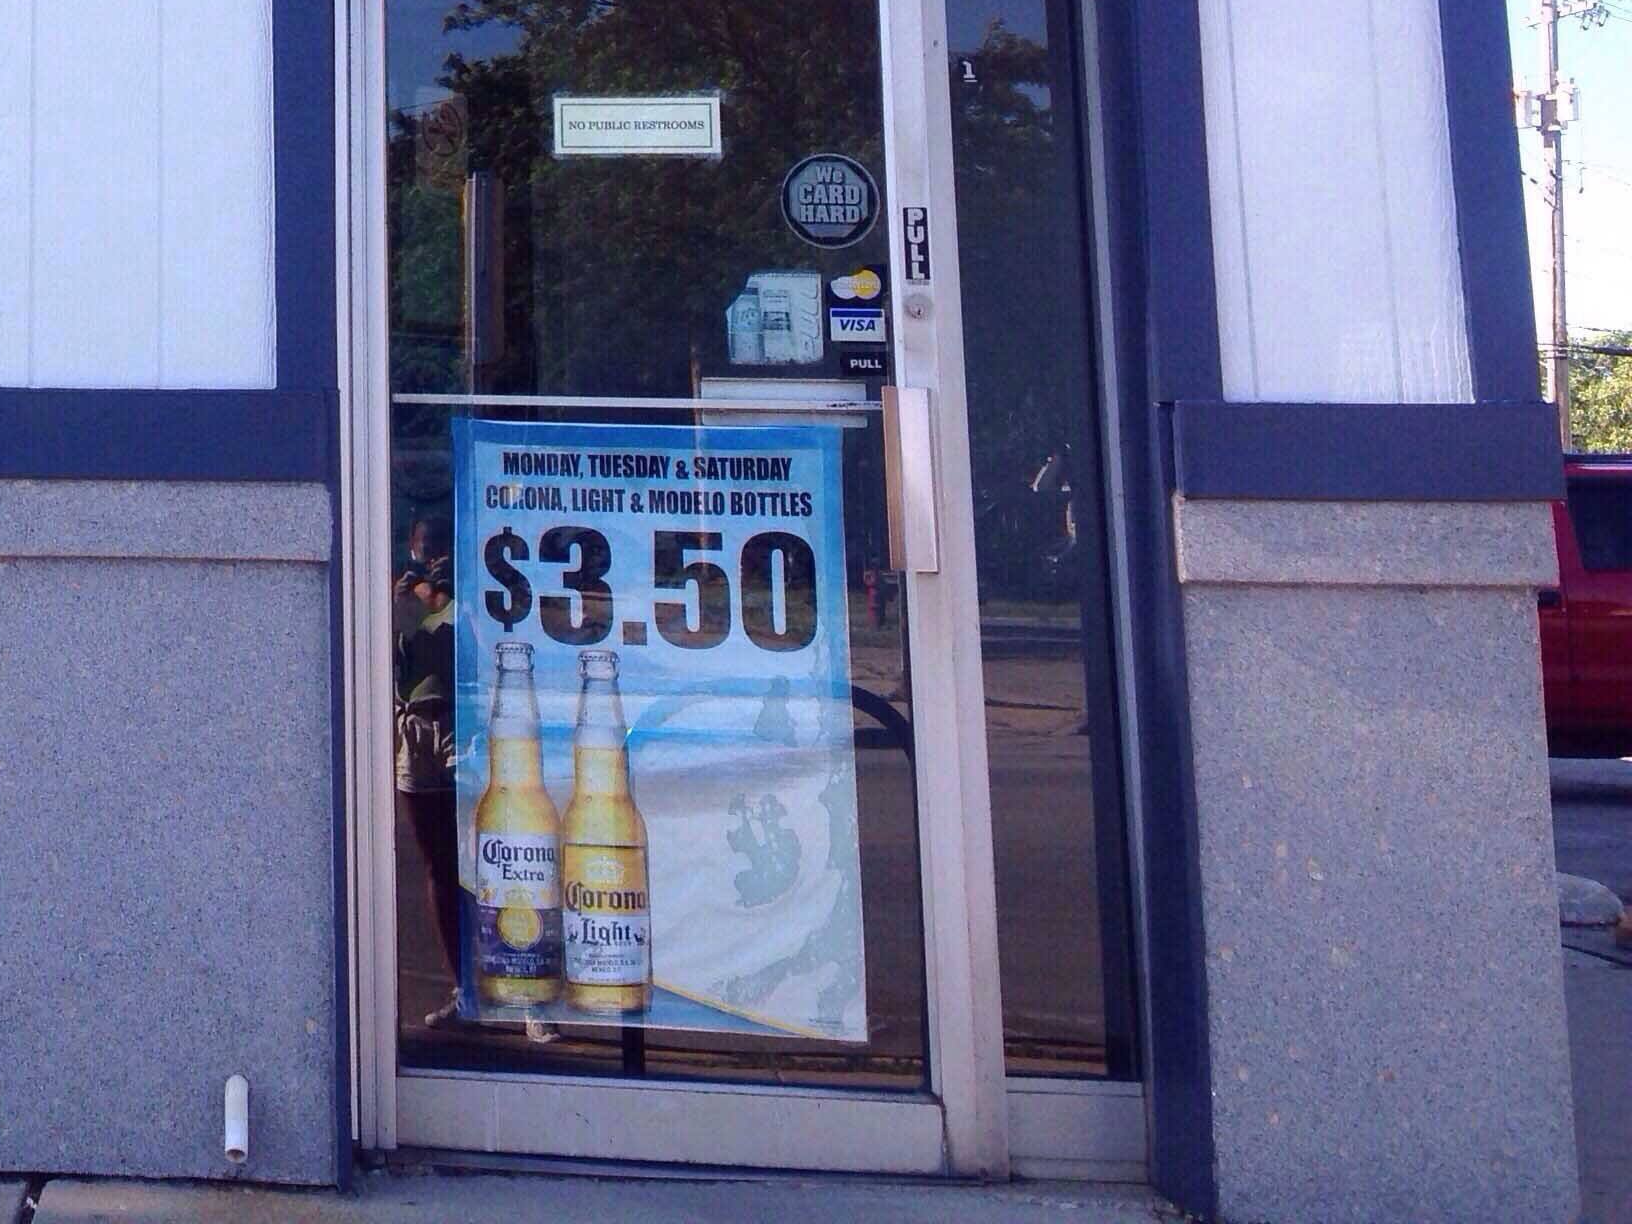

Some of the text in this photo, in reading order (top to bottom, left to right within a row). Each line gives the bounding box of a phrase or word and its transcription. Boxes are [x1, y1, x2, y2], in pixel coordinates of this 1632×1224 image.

[568, 120, 705, 131] NO PUBLIC RESTROOMS
[815, 166, 845, 183] We
[799, 184, 860, 204] CARD
[799, 205, 860, 223] HARD
[906, 208, 926, 280] PULL
[839, 319, 876, 331] VISA
[850, 359, 882, 369] PULL
[502, 452, 793, 481] MONDAY, TUESDAY & SATURDAY
[486, 484, 813, 517] CORONA, LIGHT & MODELO BOTTLES
[482, 526, 818, 652] $3.50
[482, 839, 555, 868] Corona
[502, 864, 545, 881] Extra
[564, 881, 646, 916] Corona
[581, 917, 631, 946] Light
